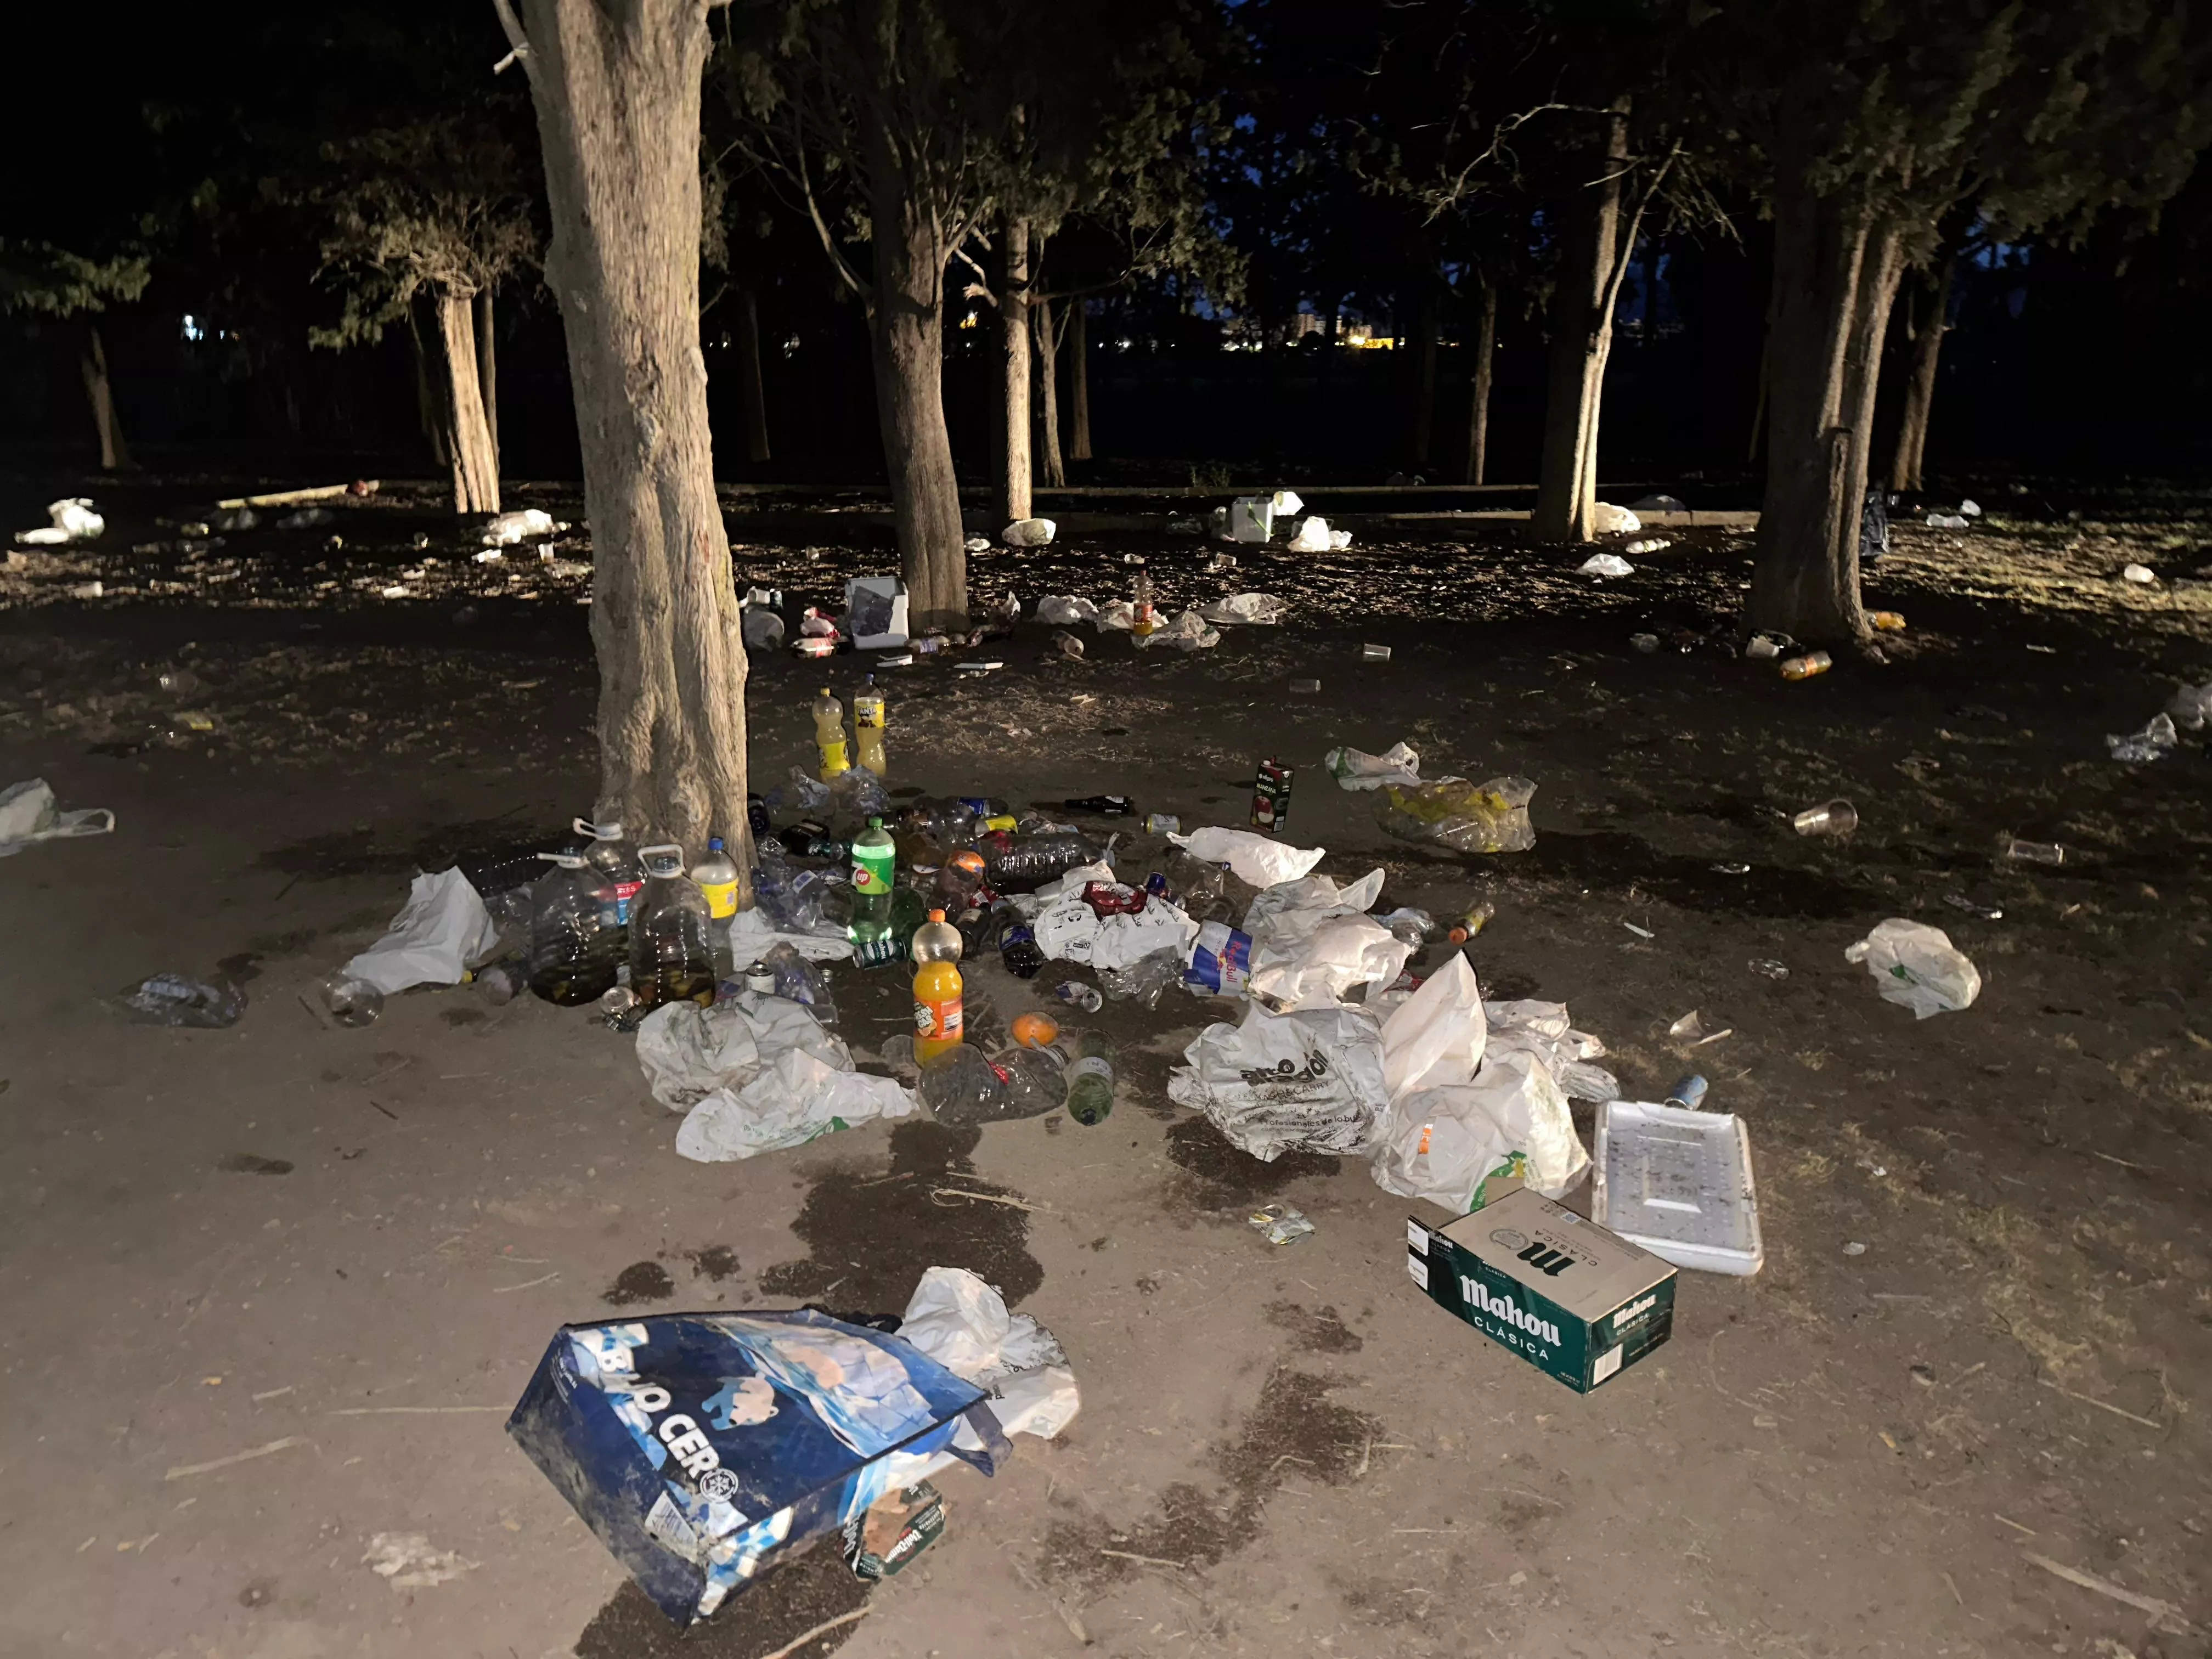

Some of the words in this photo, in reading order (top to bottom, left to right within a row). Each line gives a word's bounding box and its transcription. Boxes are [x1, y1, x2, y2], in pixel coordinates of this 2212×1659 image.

[1459, 1275, 1562, 1347] Mahou
[1613, 1294, 1657, 1329] Mahou
[1475, 1317, 1549, 1361] CLÁSICA
